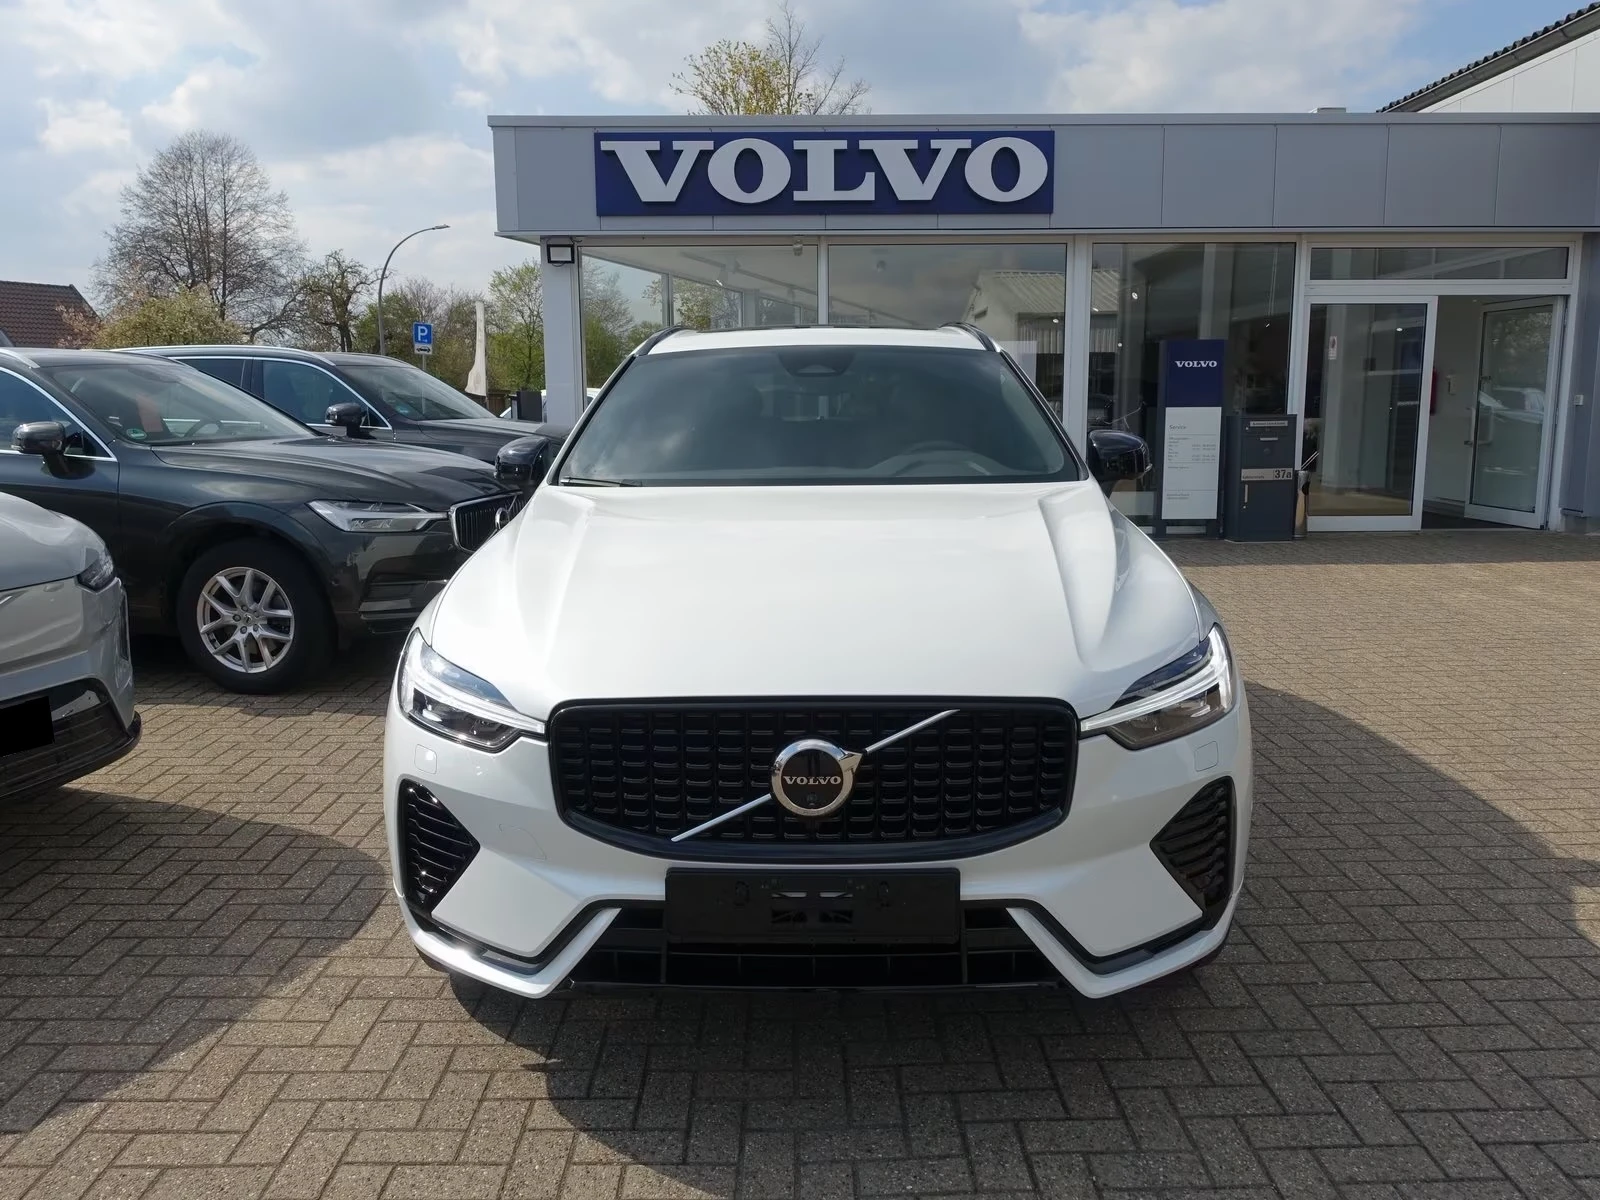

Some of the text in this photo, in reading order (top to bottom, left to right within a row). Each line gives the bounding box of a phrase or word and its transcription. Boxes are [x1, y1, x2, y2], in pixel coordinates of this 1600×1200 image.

[599, 136, 1049, 204] VOLVO
[417, 325, 428, 341] P
[1174, 360, 1218, 368] VOLVO
[1274, 469, 1292, 479] 37a
[783, 775, 842, 785] VOLVO
